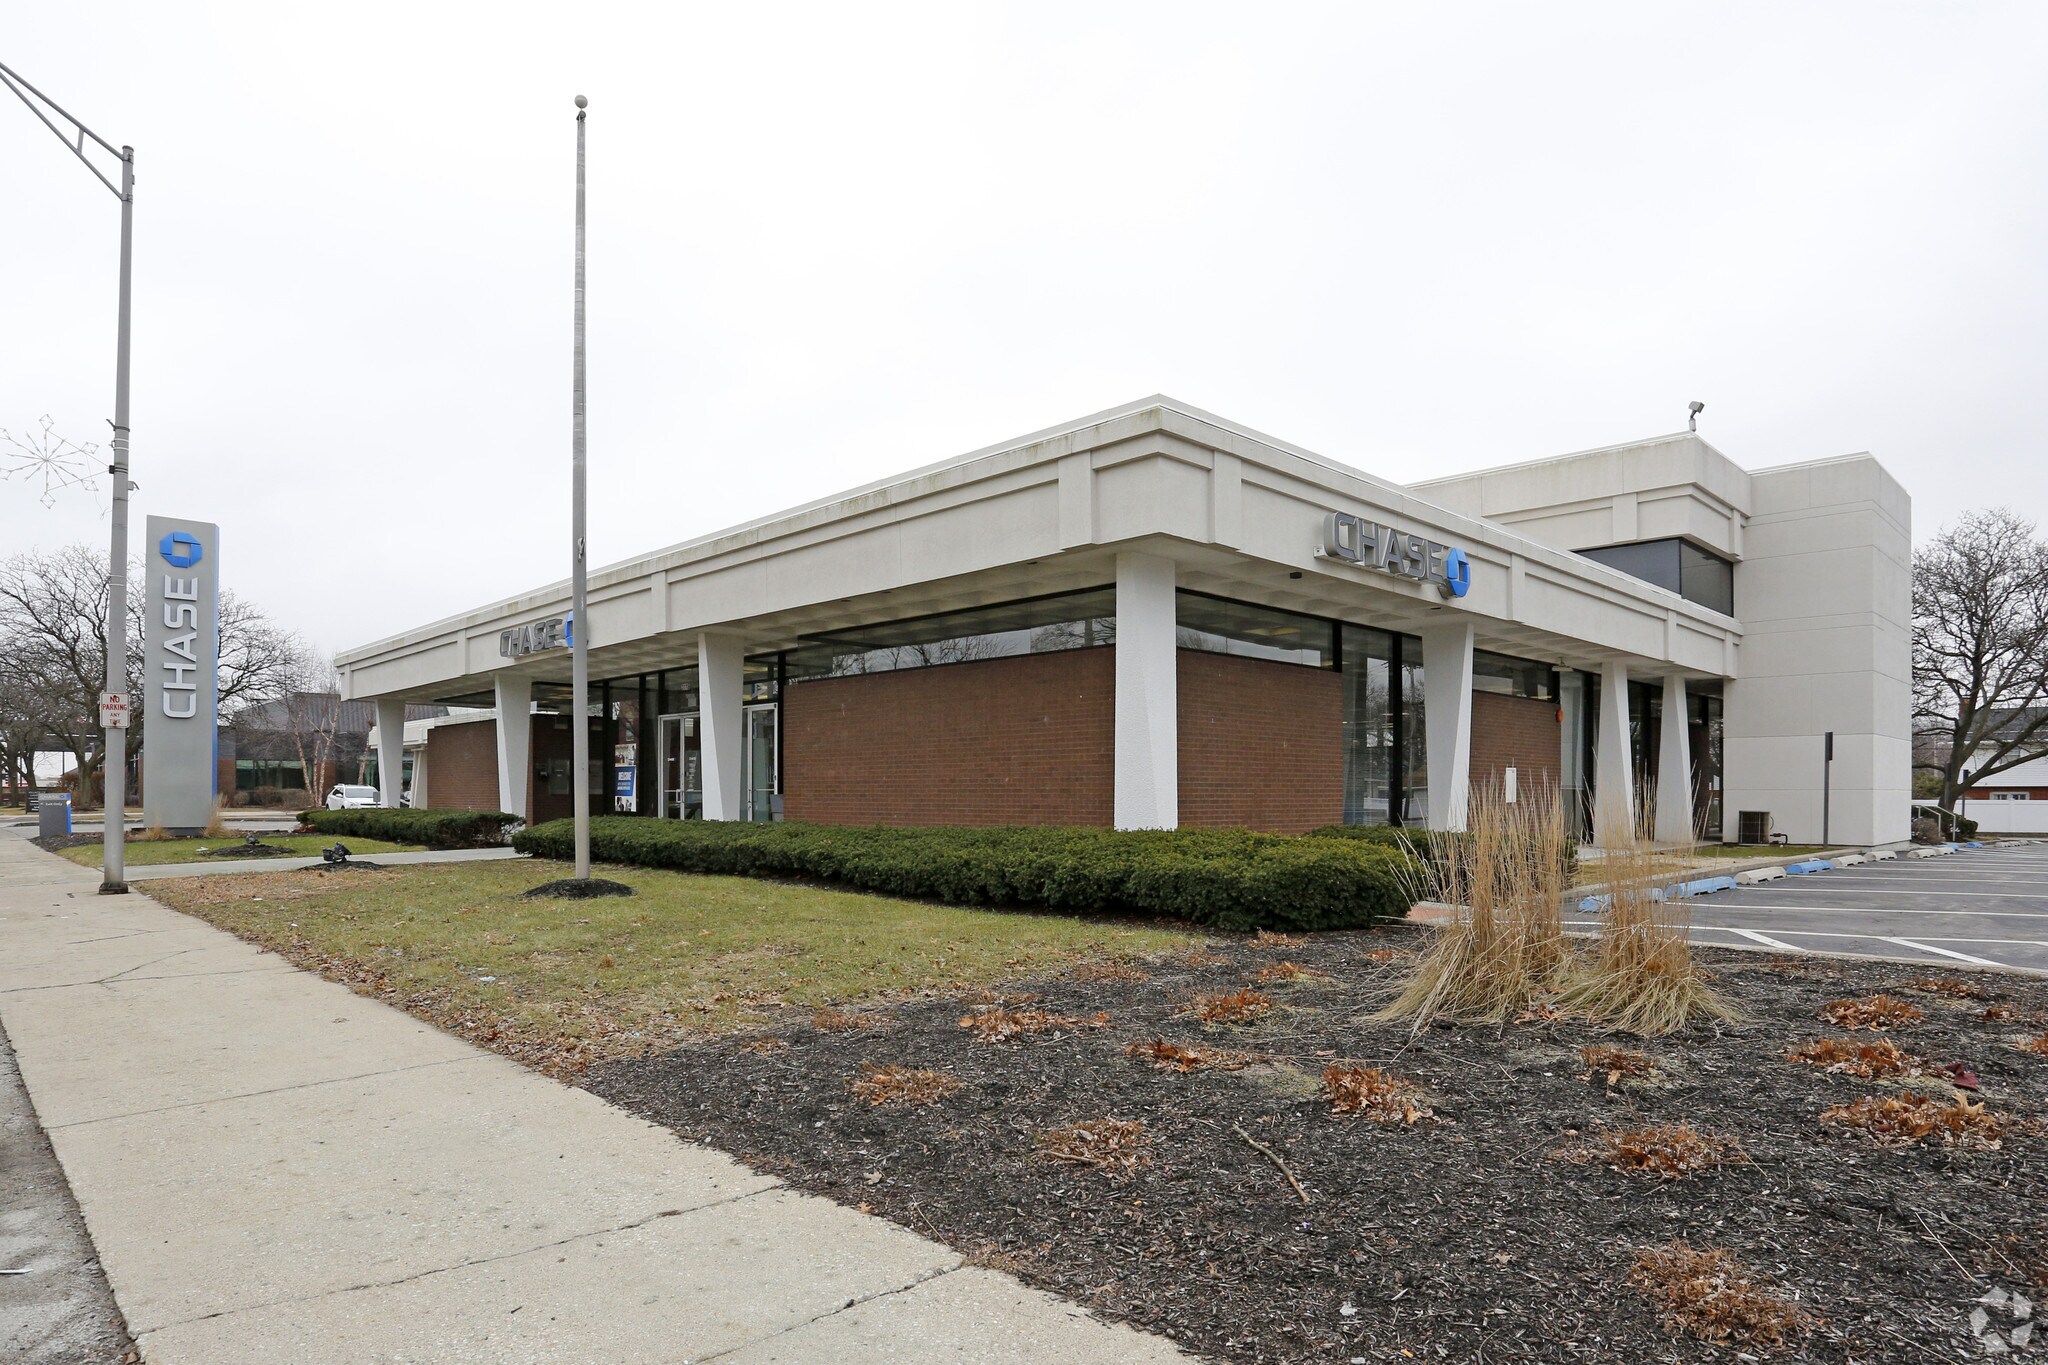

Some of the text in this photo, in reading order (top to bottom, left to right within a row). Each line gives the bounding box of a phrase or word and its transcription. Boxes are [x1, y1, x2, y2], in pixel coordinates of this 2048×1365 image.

[1323, 511, 1445, 584] CHASE
[163, 574, 199, 718] CHASE
[500, 618, 563, 658] CHASE
